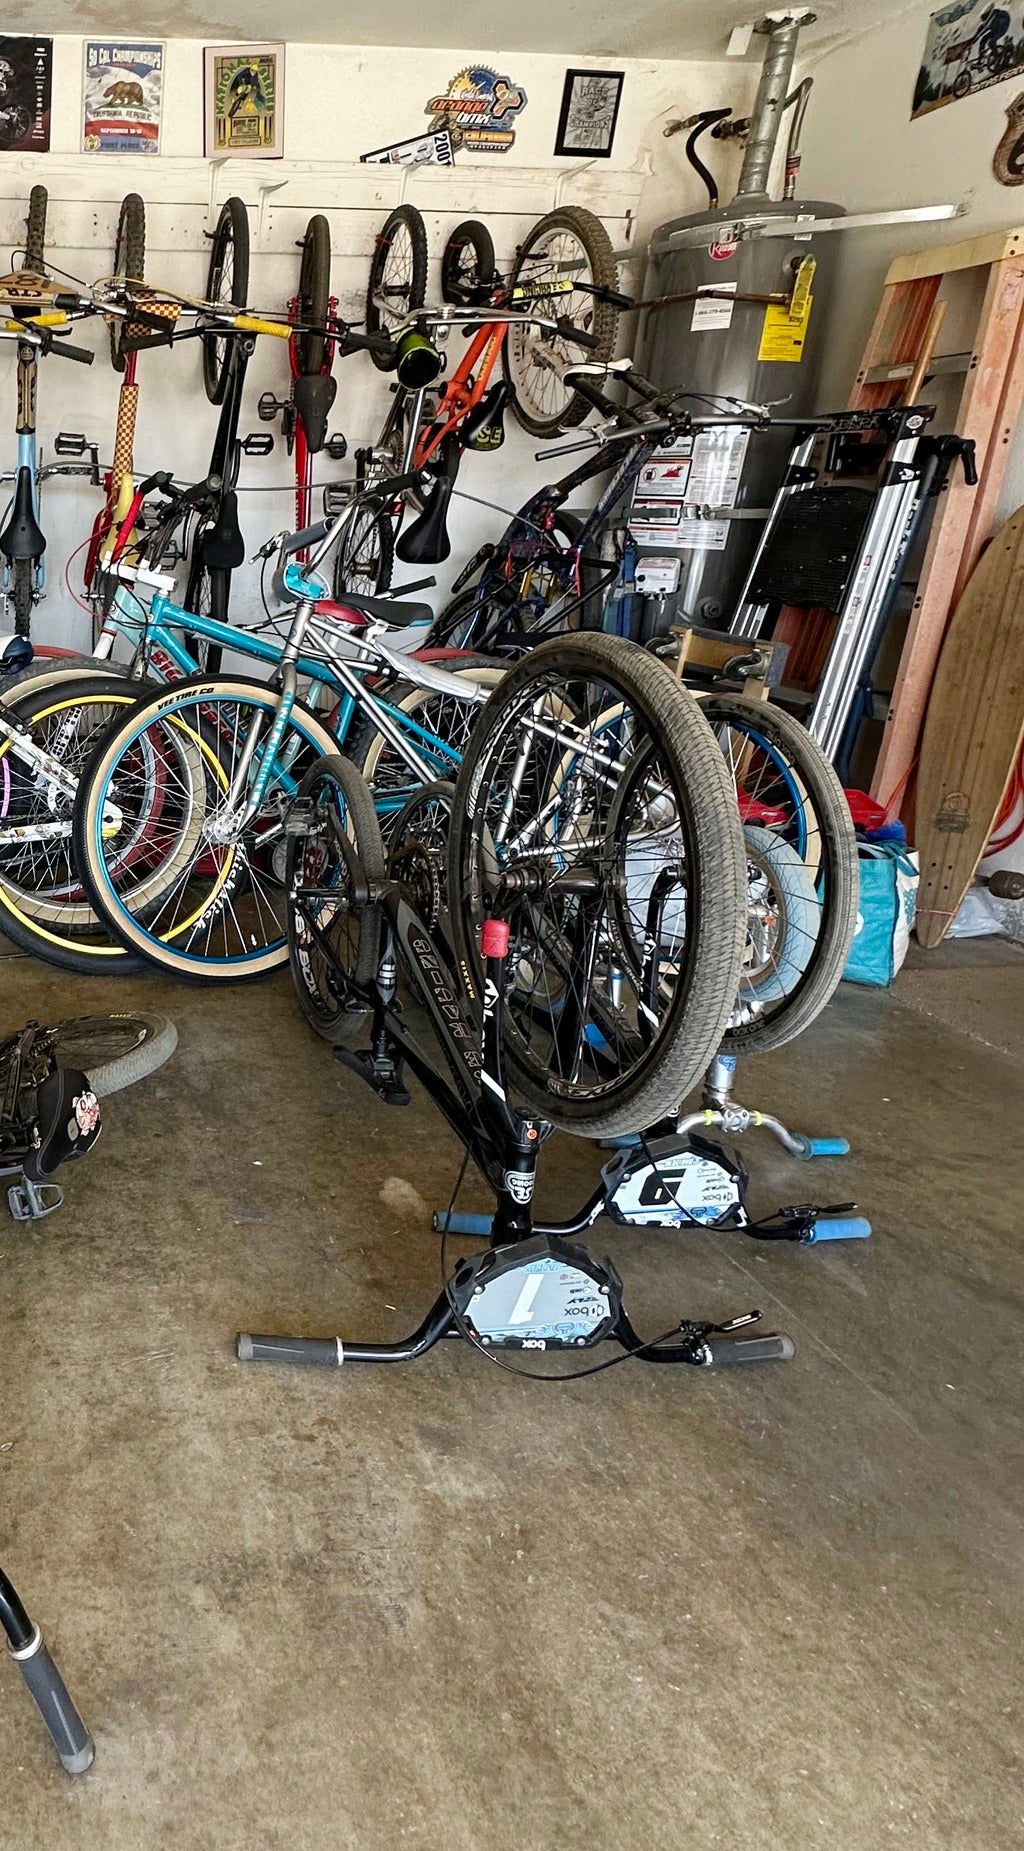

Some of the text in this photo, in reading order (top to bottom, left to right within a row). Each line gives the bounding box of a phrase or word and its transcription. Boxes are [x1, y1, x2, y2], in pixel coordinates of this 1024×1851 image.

[477, 426, 503, 443] SE
[157, 698, 174, 711] VEE
[175, 690, 196, 702] TIRE
[460, 959, 476, 999] MAXXIS
[701, 1193, 722, 1202] box
[508, 1273, 545, 1325] 1
[564, 1305, 589, 1317] box
[521, 1339, 546, 1351] box
